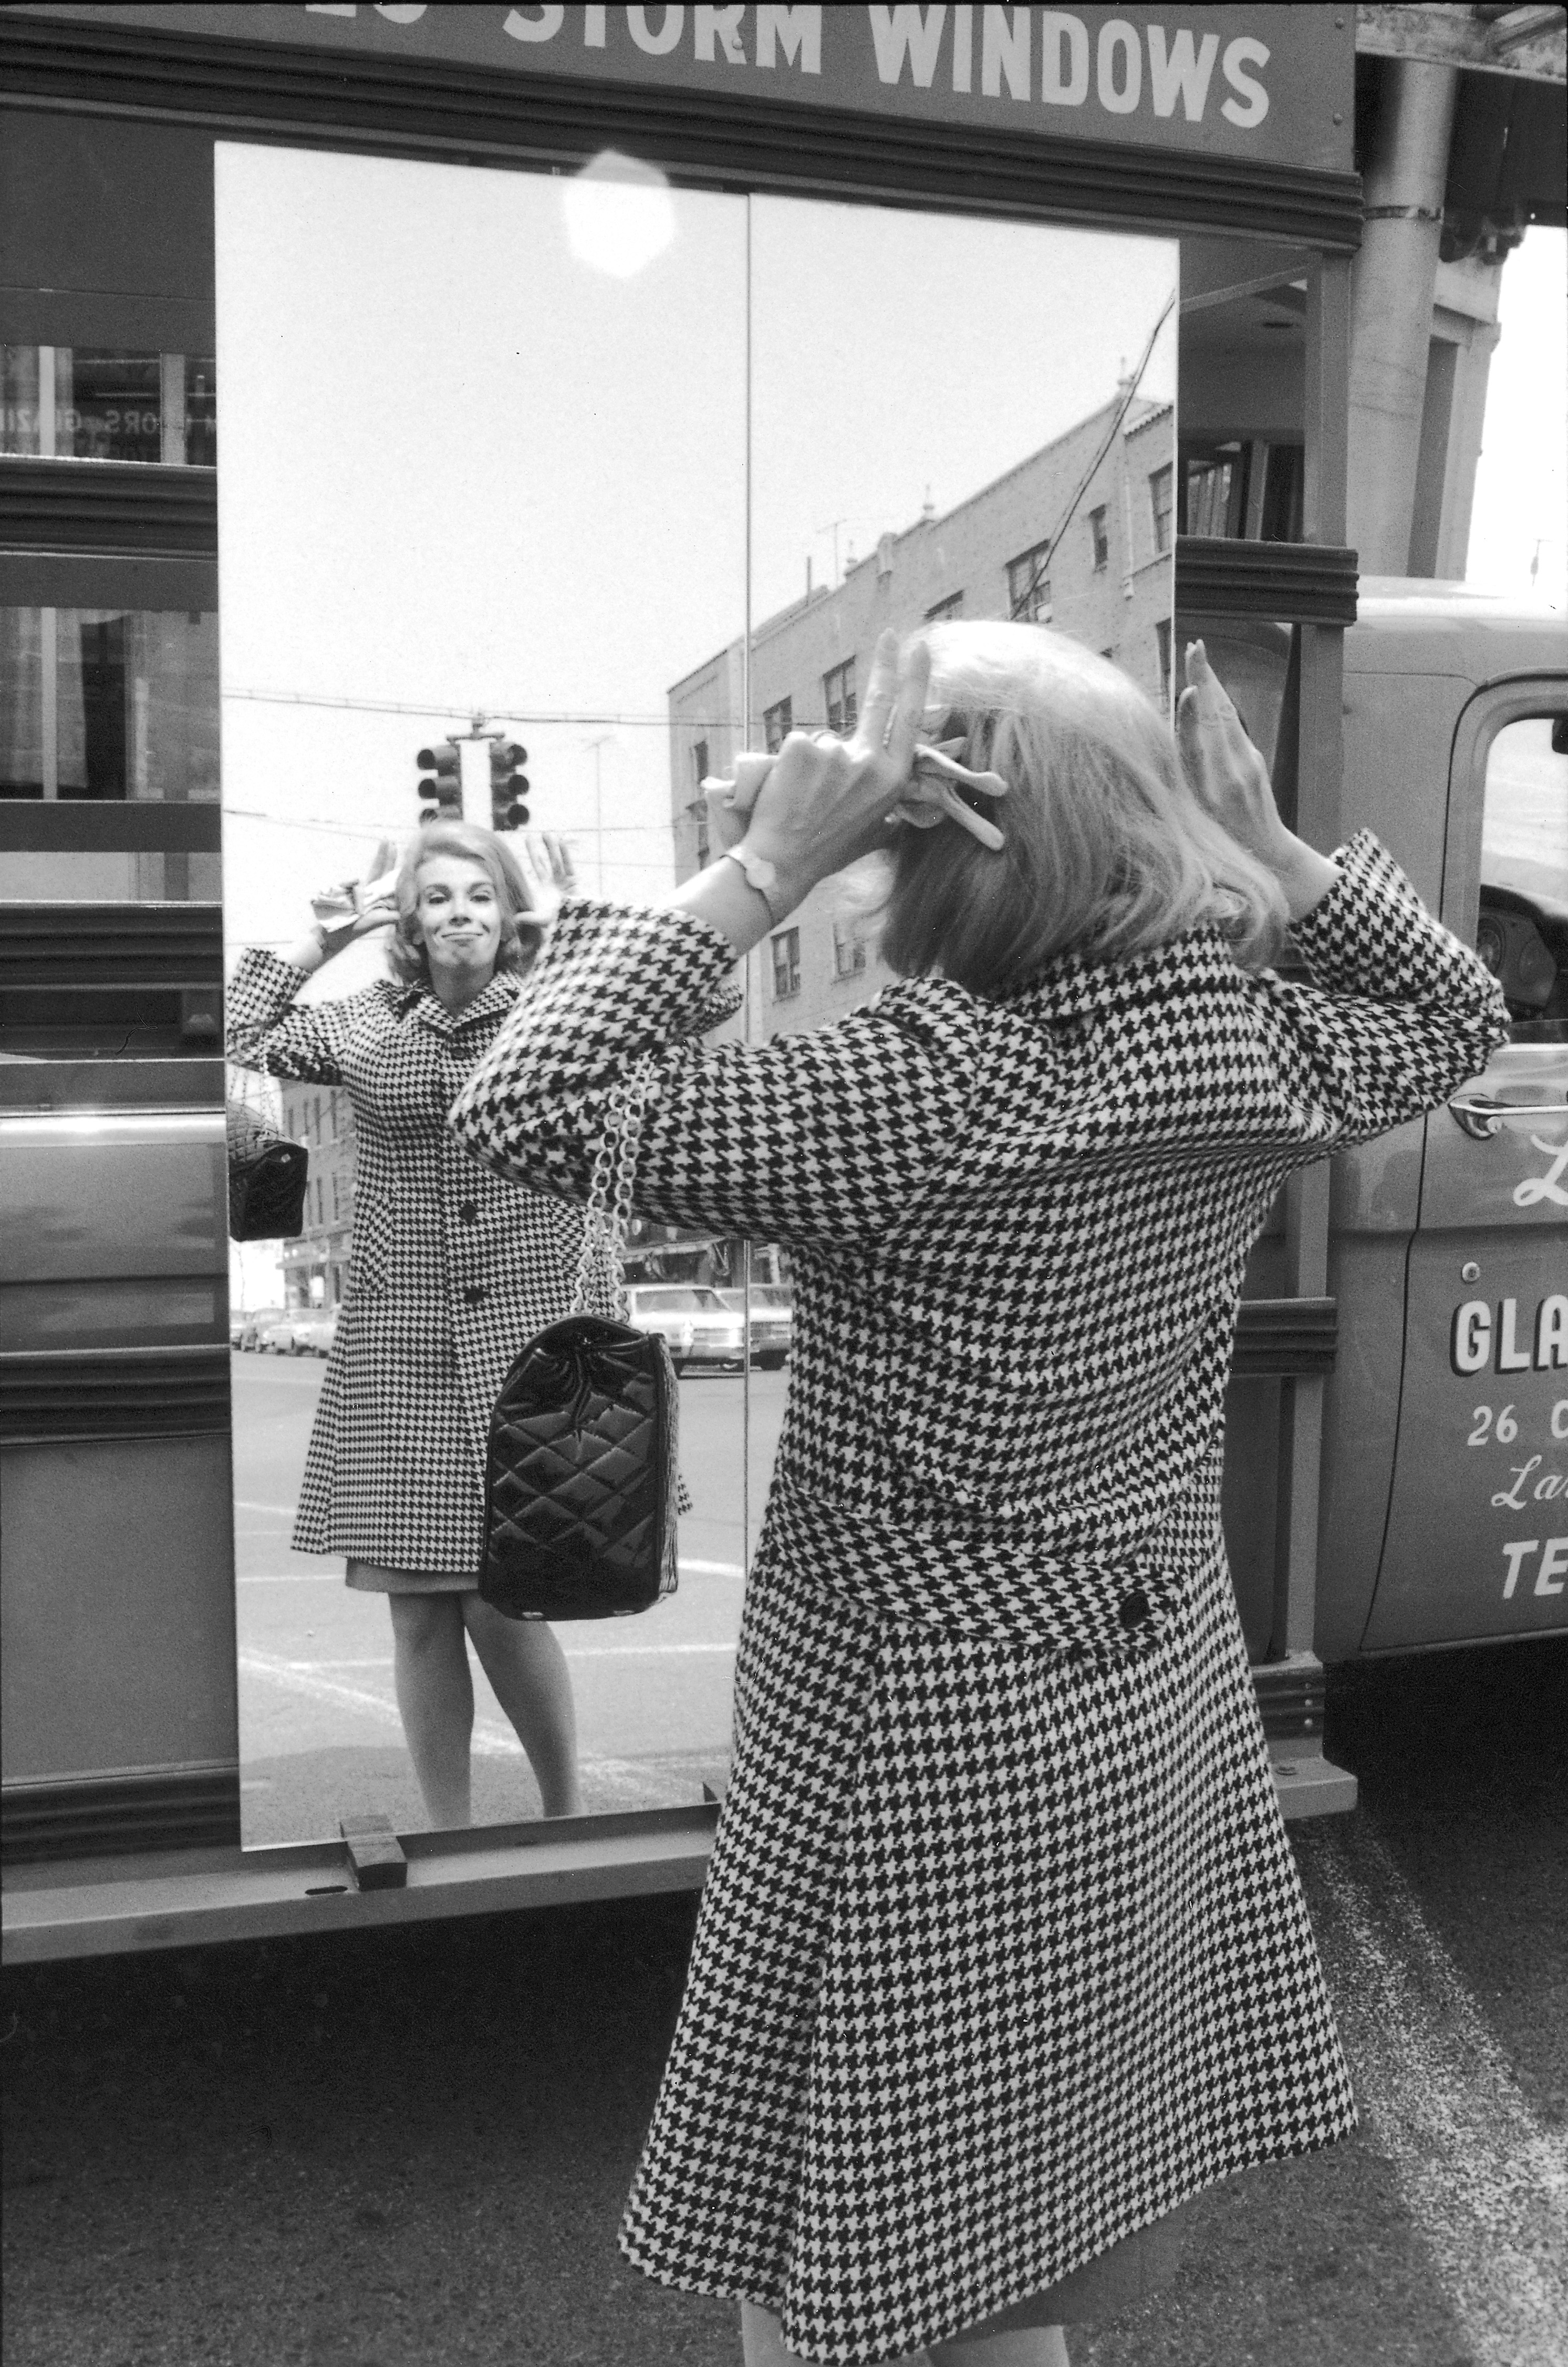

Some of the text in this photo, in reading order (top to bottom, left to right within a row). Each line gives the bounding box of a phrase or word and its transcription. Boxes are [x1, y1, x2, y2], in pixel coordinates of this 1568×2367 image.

[868, 5, 1271, 128] WINDOWS
[1467, 1404, 1519, 1446] 26
[1491, 1454, 1568, 1510] La
